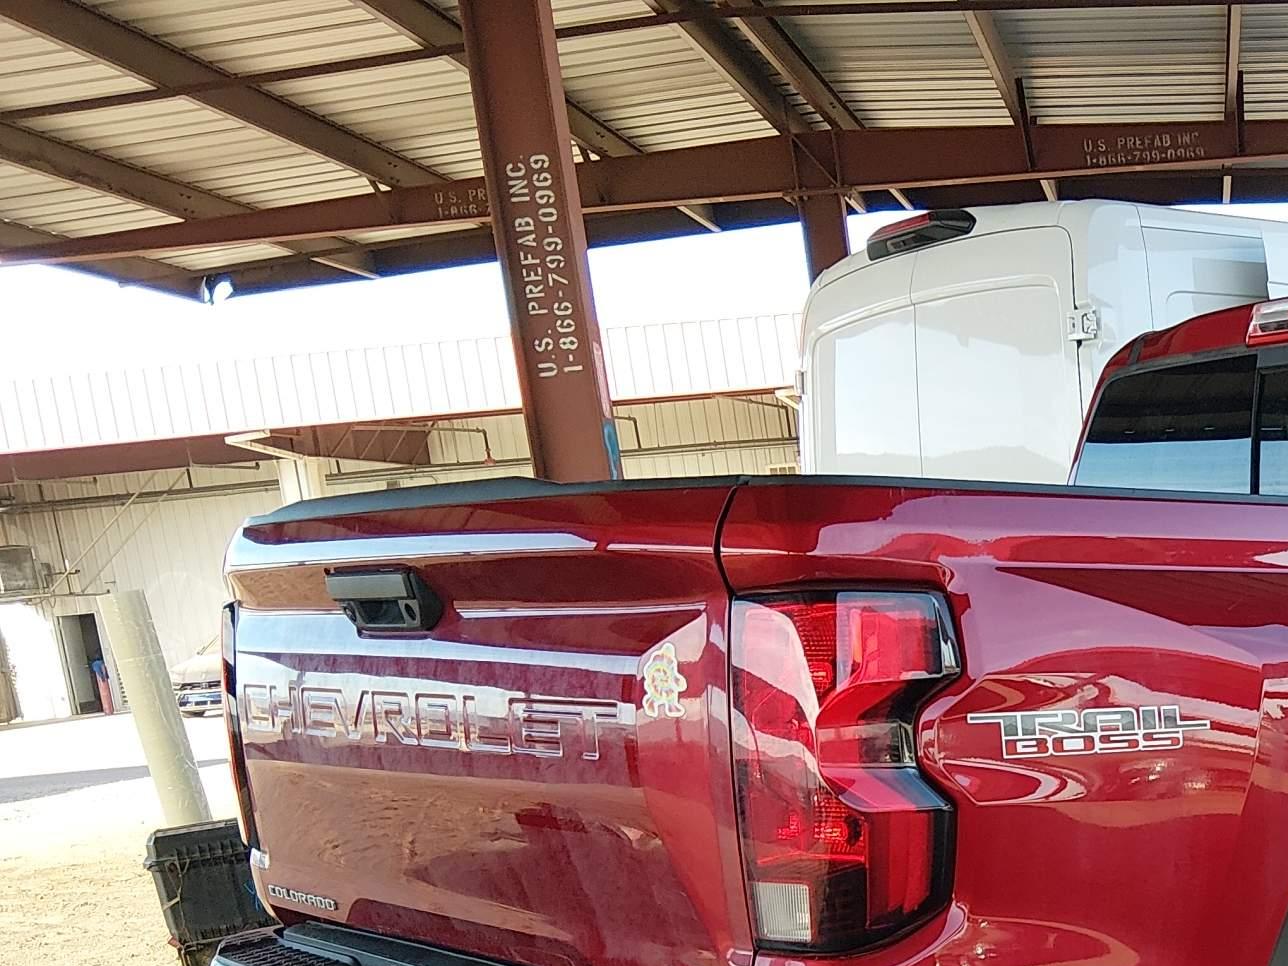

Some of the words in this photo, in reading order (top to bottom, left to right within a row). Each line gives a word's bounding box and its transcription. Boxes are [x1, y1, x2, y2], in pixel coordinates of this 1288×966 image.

[1083, 138, 1111, 153] U.S.
[1117, 134, 1171, 149] PREFAB
[506, 154, 531, 203] INC.
[514, 216, 549, 315] PREFAB
[529, 153, 584, 373] 1-866-799-0969
[533, 328, 558, 378] U.S.
[243, 682, 620, 761] CHEVROLET
[966, 704, 1211, 738] TRAIL
[1002, 729, 1185, 759] BOSS
[267, 884, 337, 912] COLORADO
